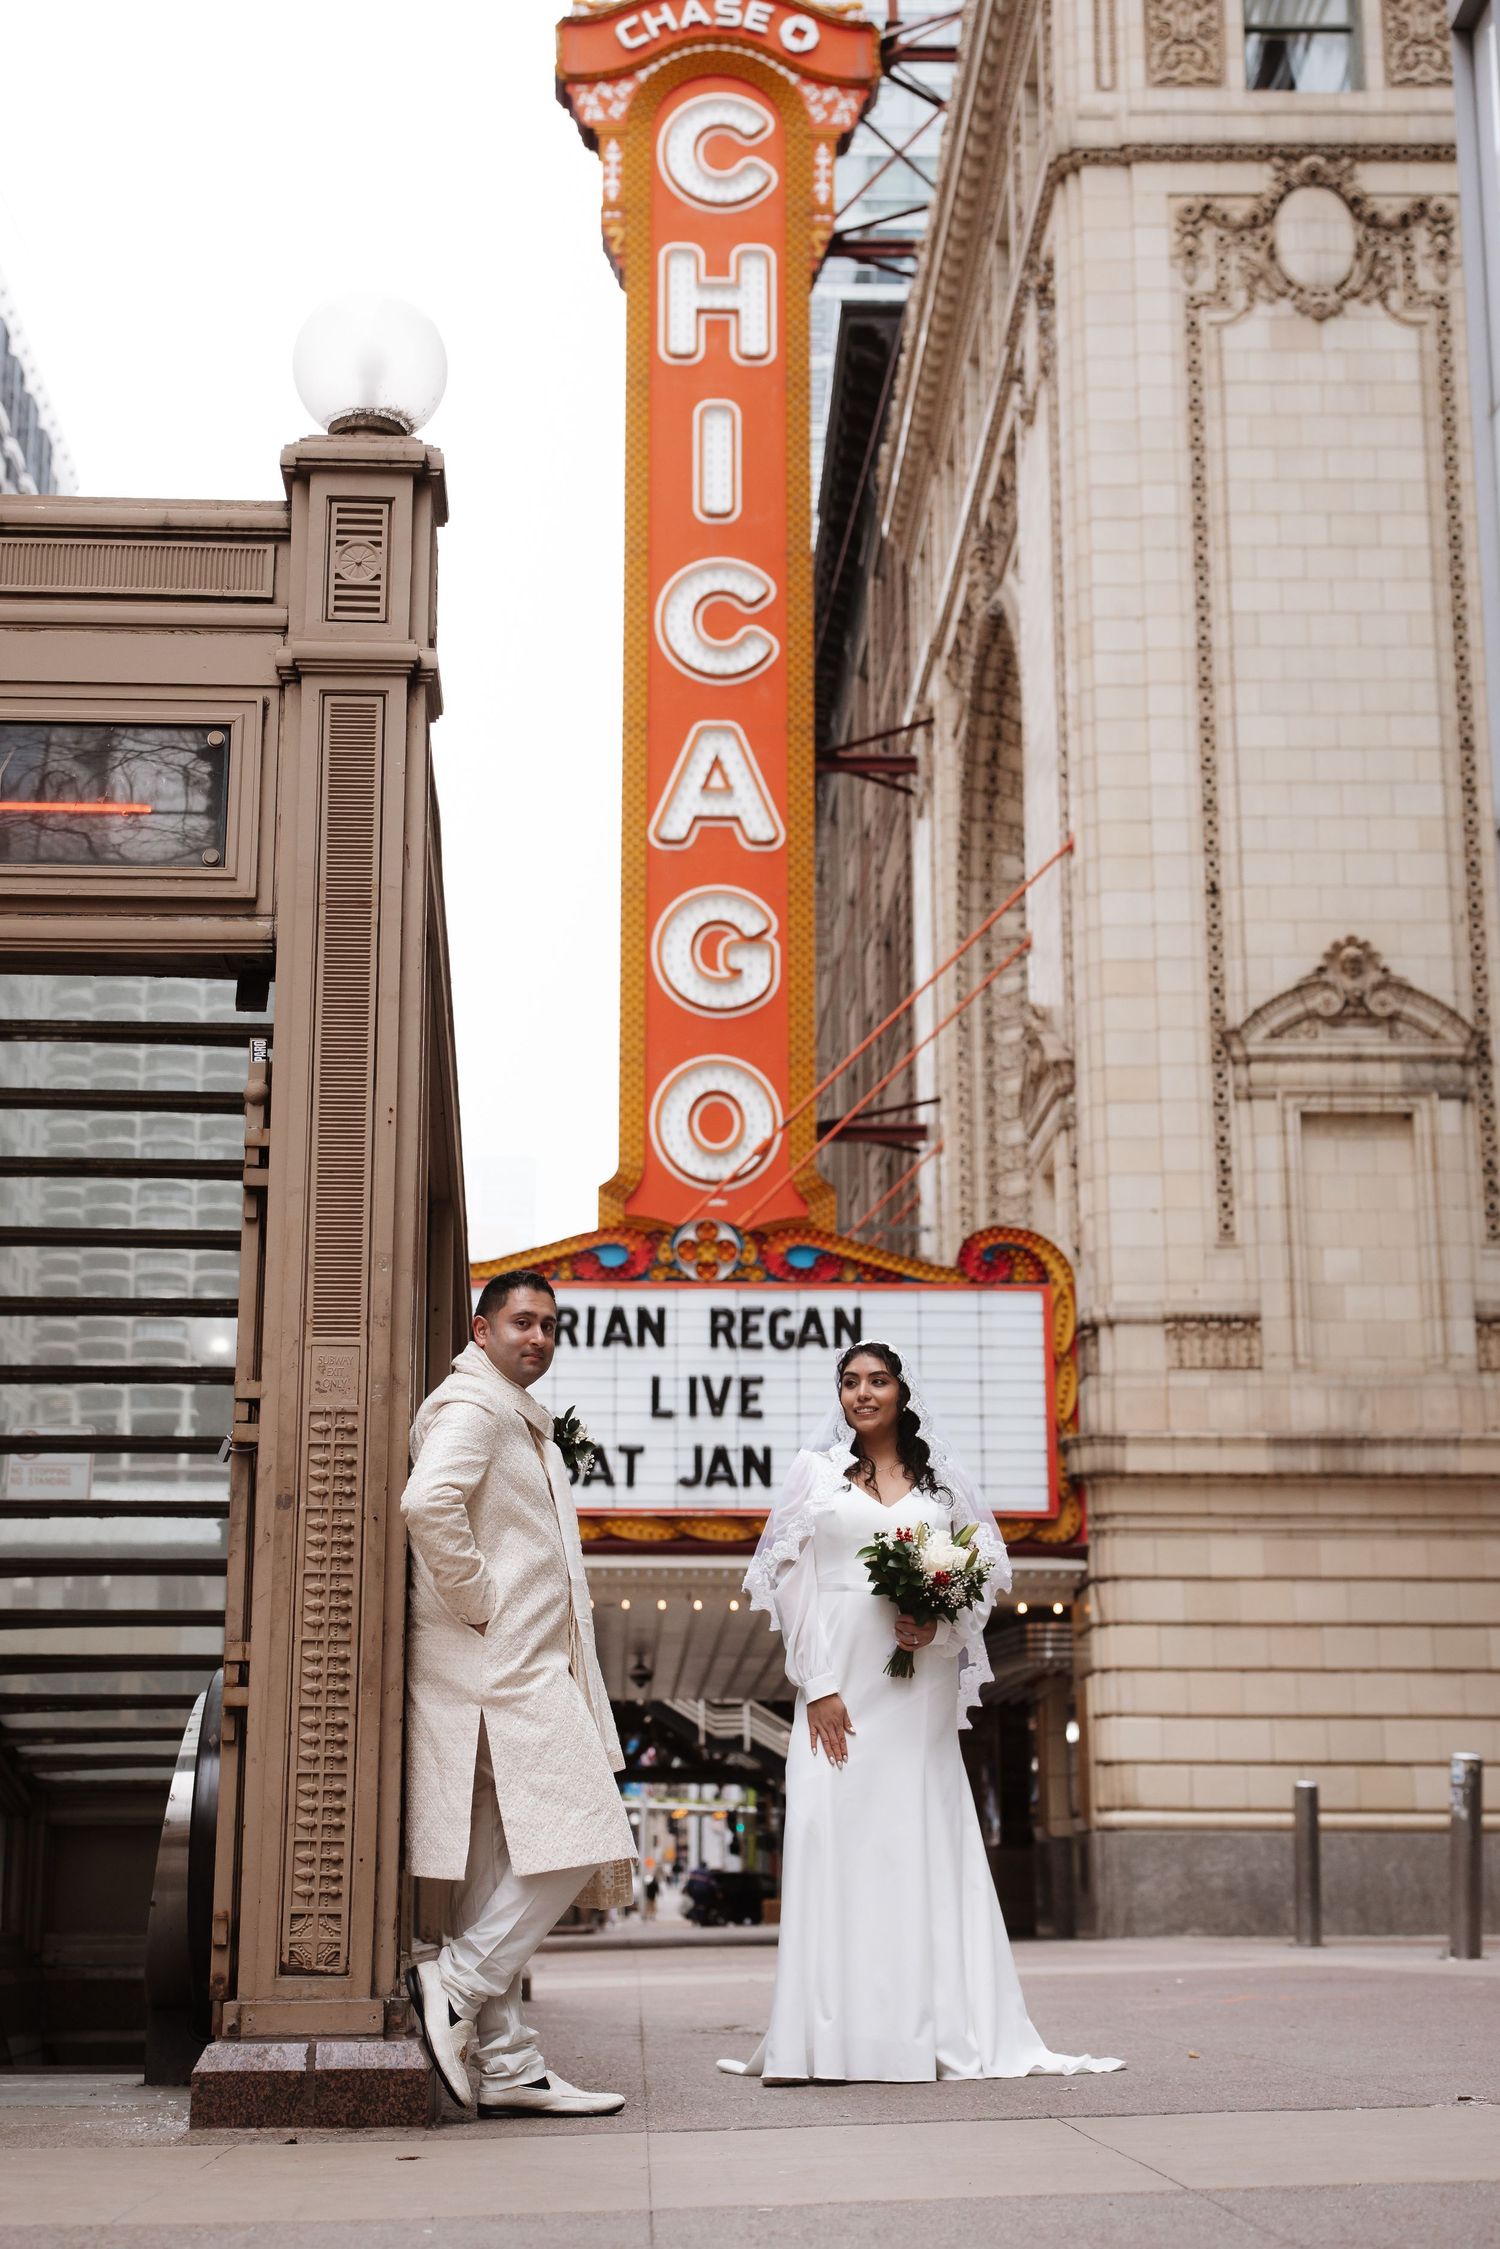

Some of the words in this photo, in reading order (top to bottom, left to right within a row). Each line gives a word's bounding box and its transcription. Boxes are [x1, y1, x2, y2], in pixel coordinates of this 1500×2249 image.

[615, 0, 775, 49] CHASE
[648, 91, 787, 1192] CHICAGO
[555, 1305, 666, 1348] RIAN
[709, 1306, 862, 1350] REGAN
[651, 1376, 764, 1419] LIVE
[570, 1444, 645, 1488] AT
[678, 1445, 772, 1488] JAN
